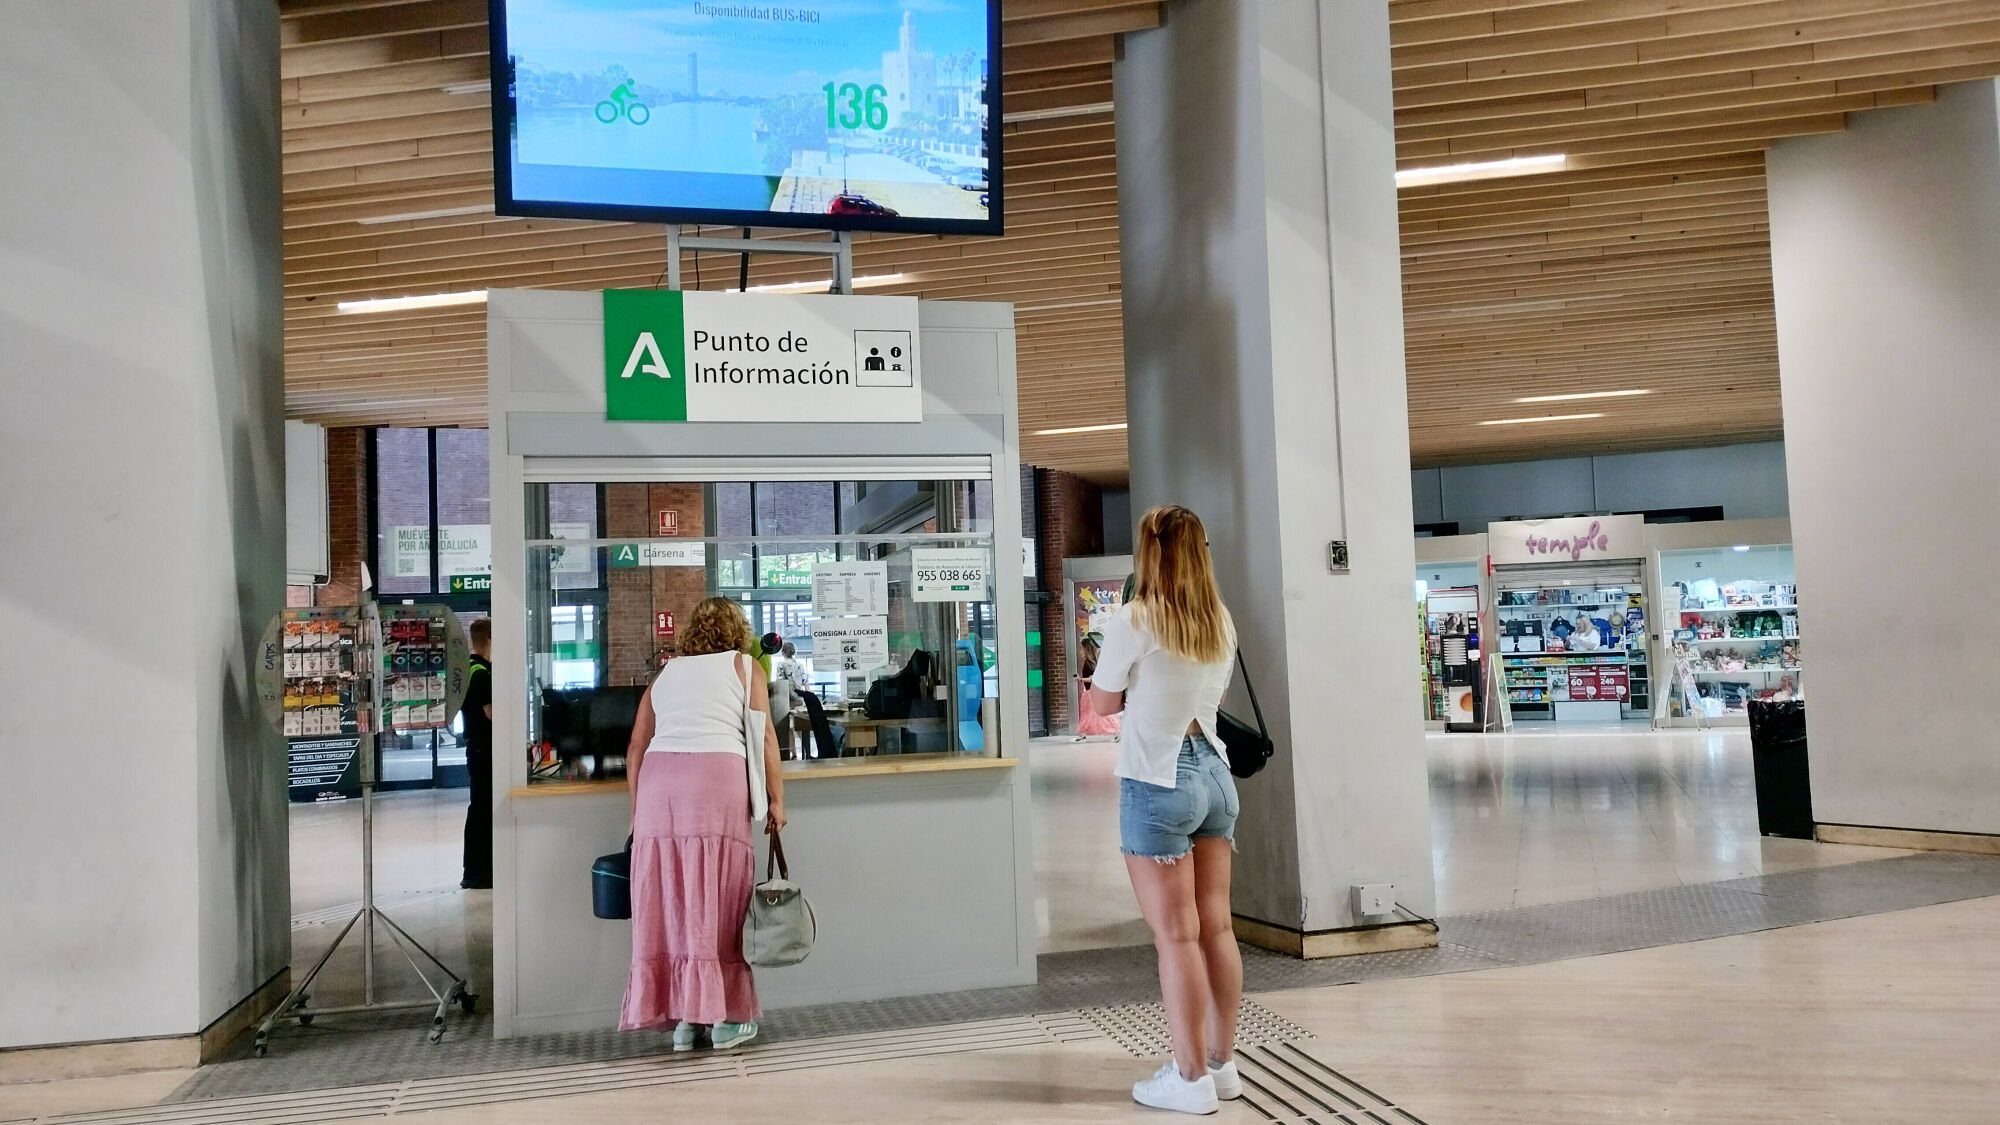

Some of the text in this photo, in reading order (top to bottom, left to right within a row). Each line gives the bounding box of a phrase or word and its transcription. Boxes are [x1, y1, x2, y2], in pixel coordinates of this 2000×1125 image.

[694, 1, 769, 21] Disponibilidad
[823, 80, 889, 131] 136
[693, 330, 808, 353] Punto de
[694, 361, 850, 385] Información
[398, 541, 416, 551] POR
[1525, 520, 1608, 560] temple
[643, 547, 685, 559] Dársena
[779, 573, 812, 585] Entrad
[917, 569, 982, 581] 955 038 665
[463, 577, 491, 590] Entr
[1094, 588, 1123, 598] tem
[843, 645, 857, 653] 6€
[844, 662, 857, 670] 9€
[1570, 678, 1583, 686] 60
